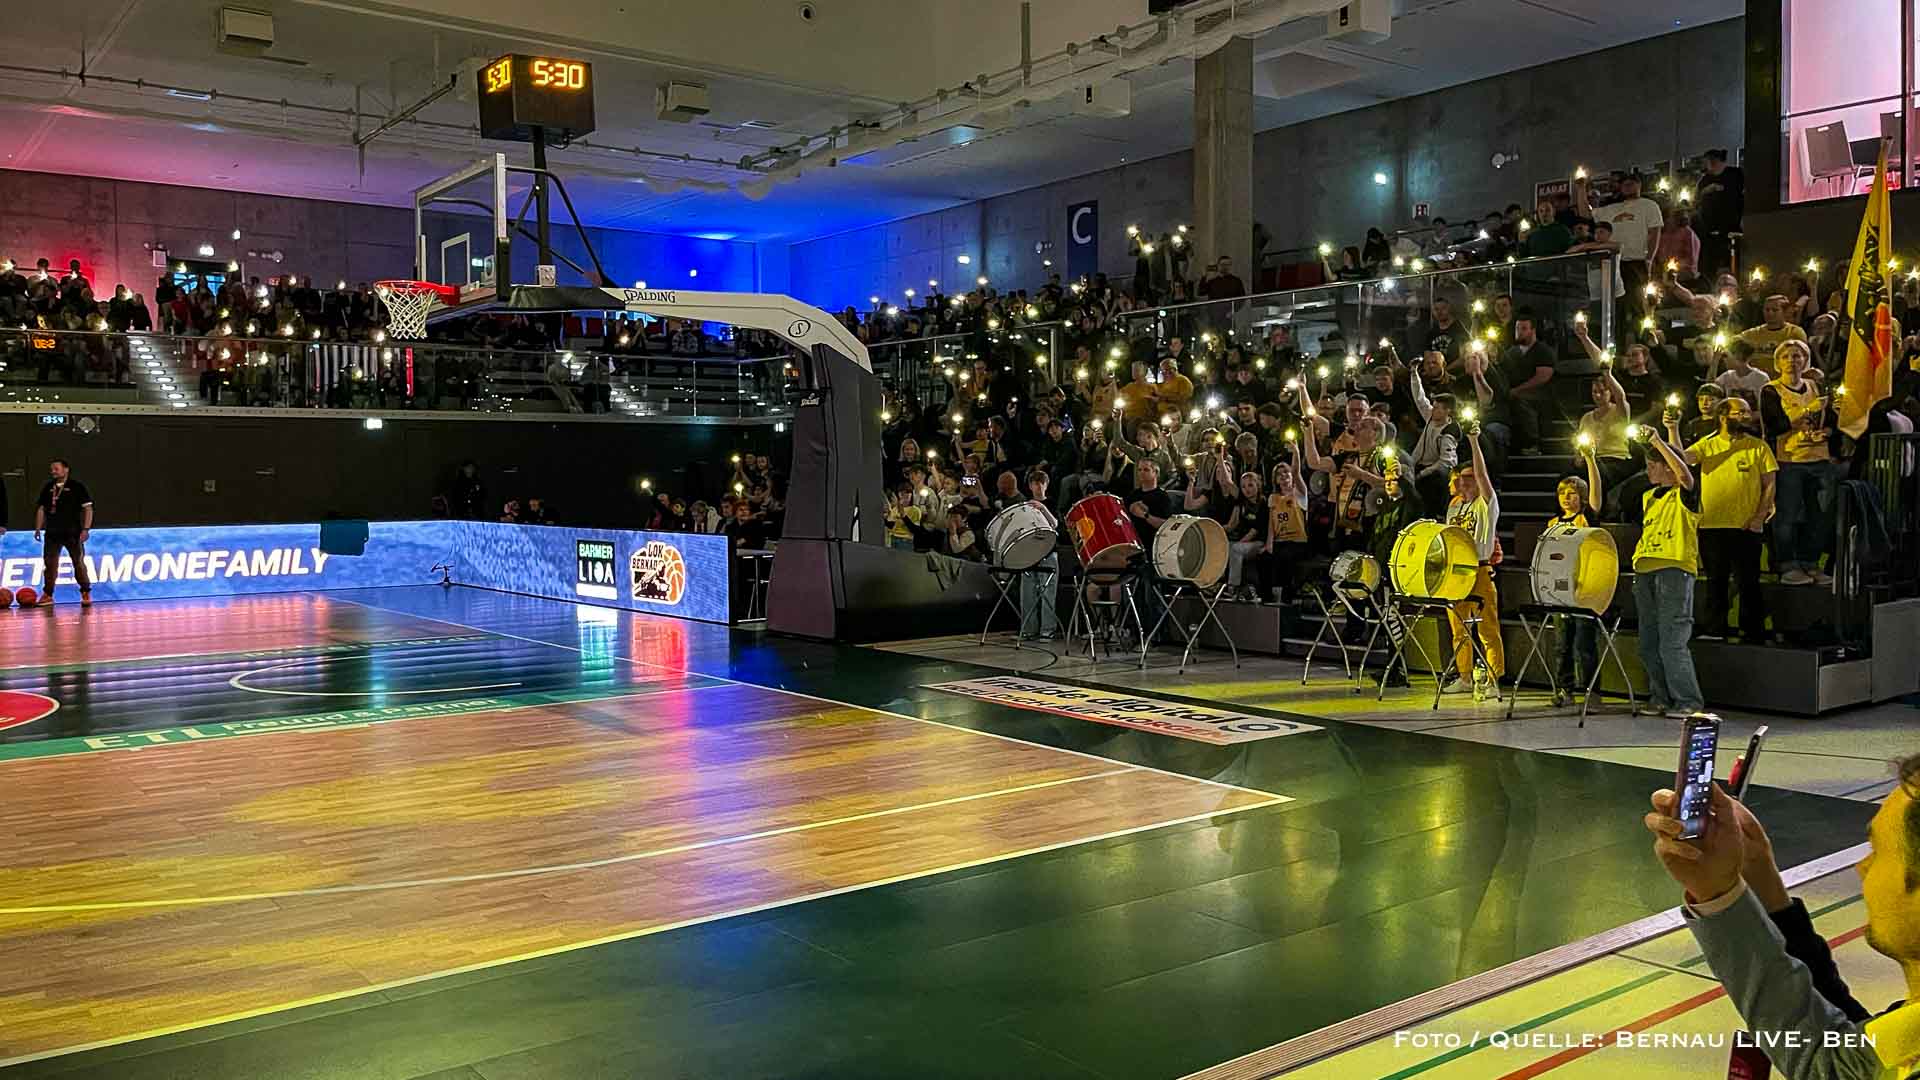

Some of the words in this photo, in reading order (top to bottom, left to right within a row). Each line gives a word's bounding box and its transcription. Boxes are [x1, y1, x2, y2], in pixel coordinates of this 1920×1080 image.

[486, 60, 511, 93] 5:30
[534, 60, 584, 89] 5:30
[1072, 207, 1092, 244] C
[624, 289, 676, 304] SPALDING
[579, 543, 613, 559] BARMER
[648, 543, 663, 558] LOK
[0, 548, 329, 587] ETEAMONEFAMILY
[973, 677, 1089, 698] inside
[1086, 696, 1249, 724] digital
[82, 727, 227, 749] ETL
[222, 713, 347, 731] Freund
[382, 698, 499, 714] Partner
